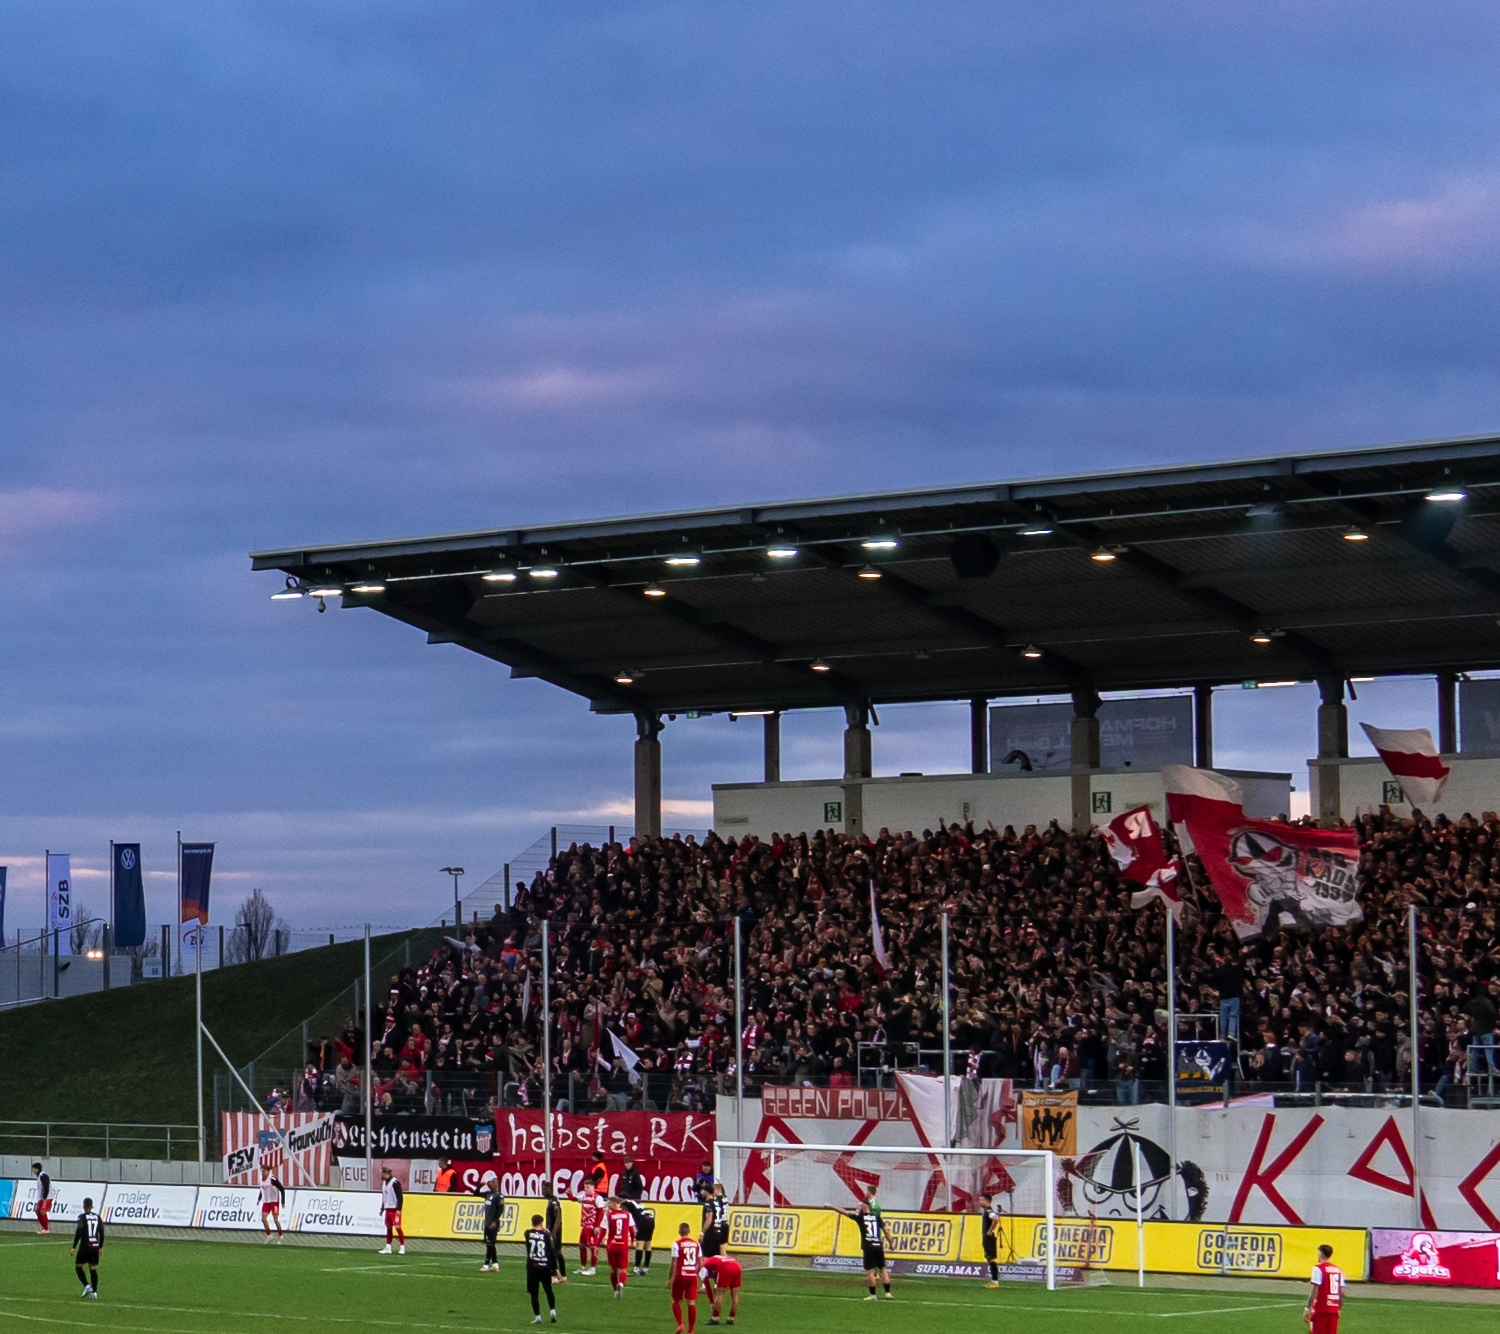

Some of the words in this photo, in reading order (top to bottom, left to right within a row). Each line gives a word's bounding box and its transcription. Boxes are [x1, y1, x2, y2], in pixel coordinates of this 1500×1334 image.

[58, 879, 69, 919] SZB
[764, 1088, 831, 1118] GEGEN
[27, 1186, 60, 1200] mer
[116, 1190, 152, 1206] maler
[209, 1192, 246, 1209] maler
[113, 1204, 161, 1220] creativ.
[307, 1195, 345, 1213] maler
[458, 1204, 514, 1218] COMIA
[206, 1207, 257, 1224] creativ.
[304, 1211, 355, 1228] creativ.
[733, 1212, 794, 1231] COMEDIA
[731, 1229, 793, 1247] CONCEPT
[1204, 1232, 1276, 1252] COMEDIA
[683, 1247, 697, 1266] 33
[813, 1255, 864, 1266] ÖKOLOGISCH
[1202, 1250, 1275, 1270] CONCEPT
[916, 1264, 983, 1276] SUPRAMAX
[1393, 1264, 1450, 1279] eSports
